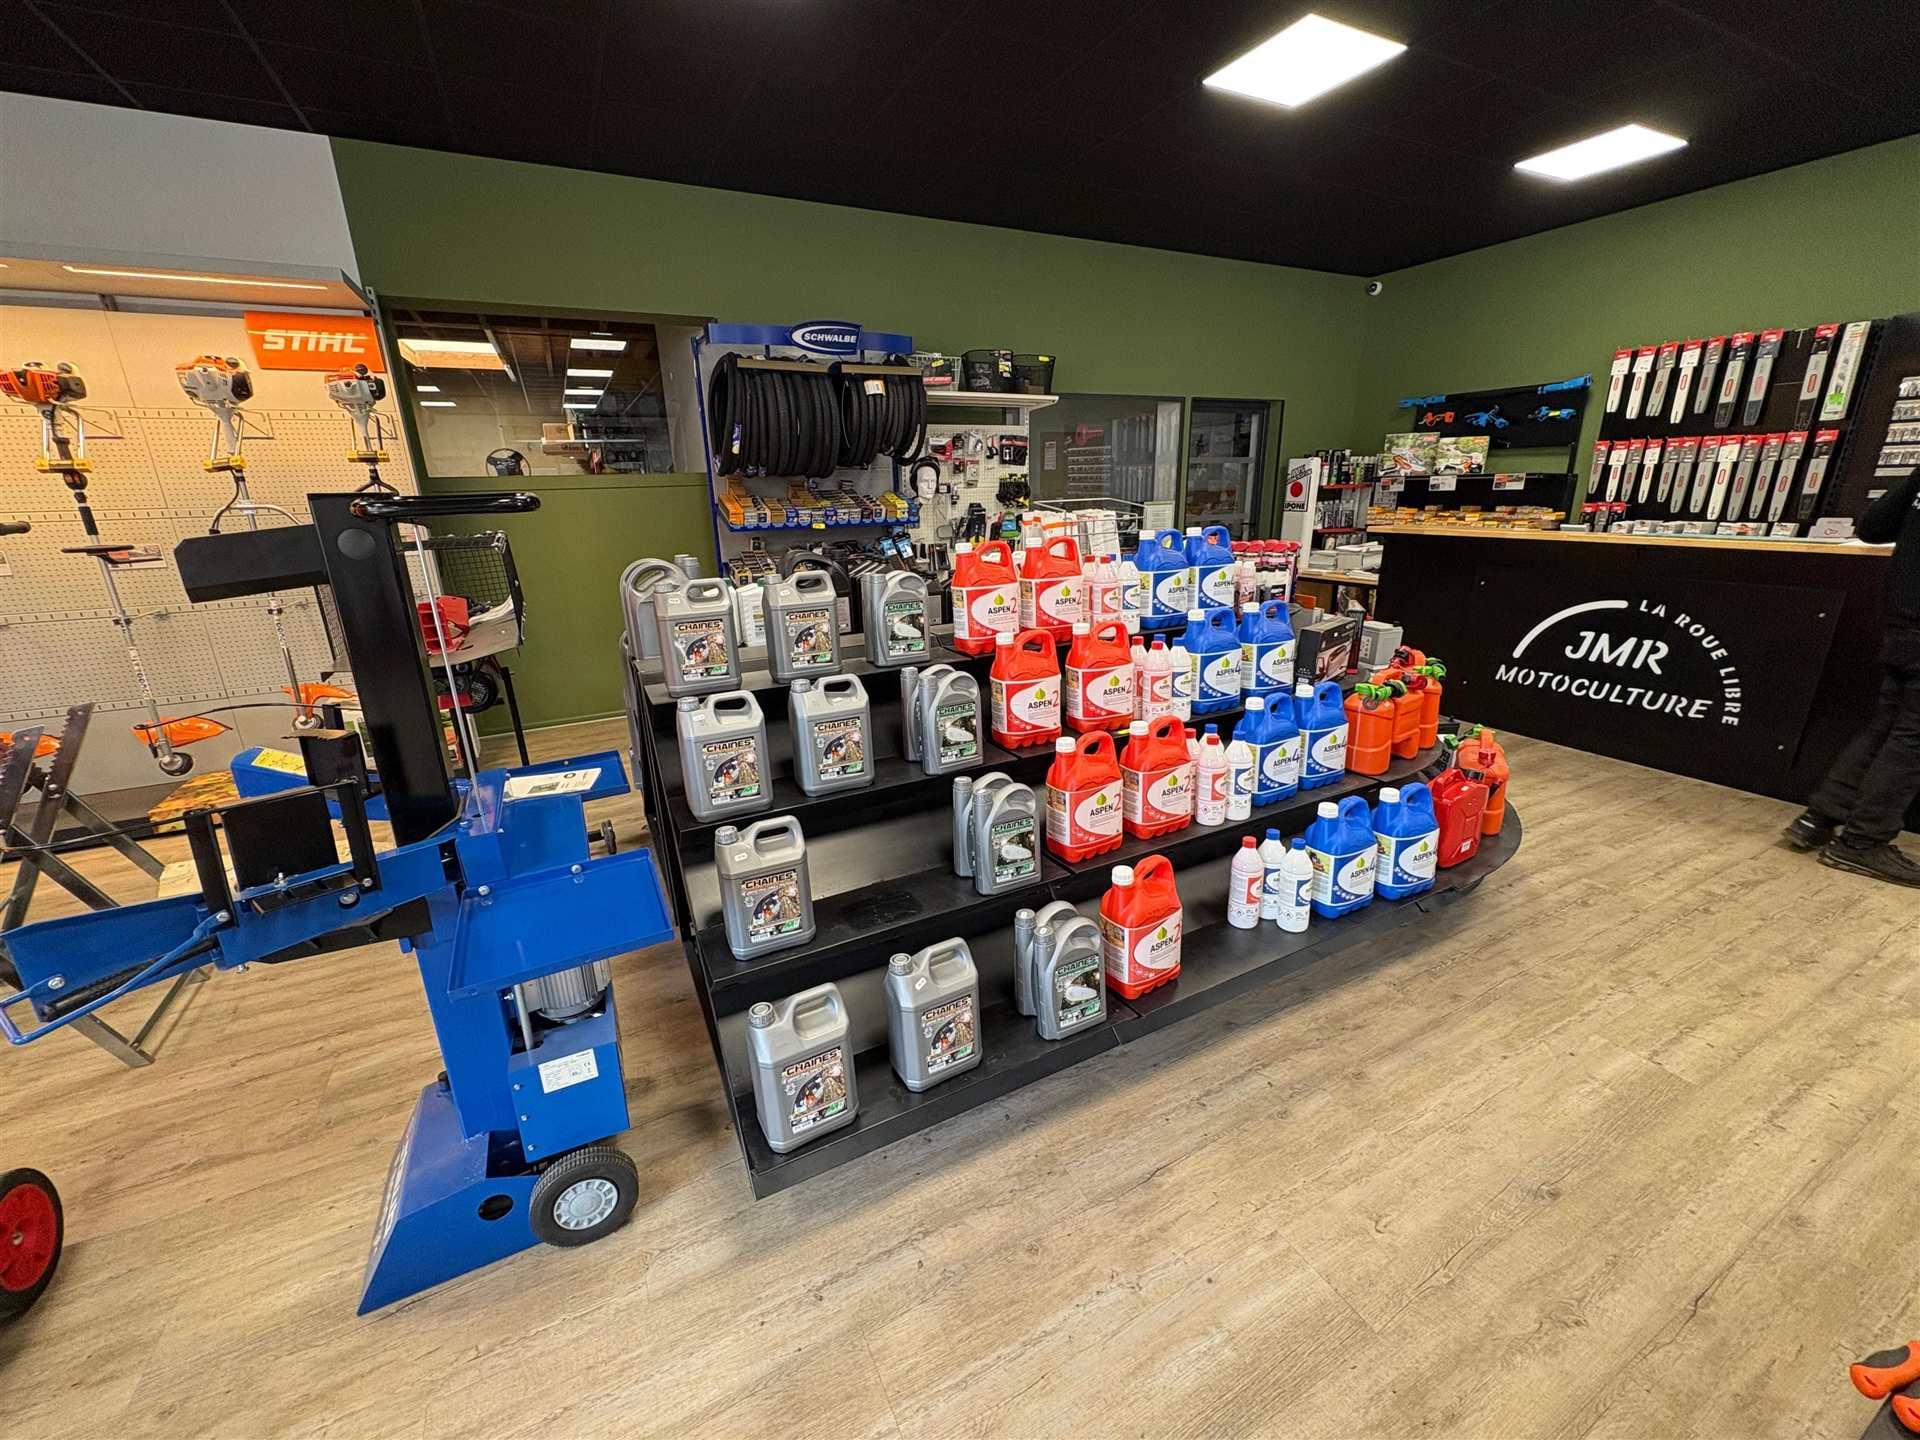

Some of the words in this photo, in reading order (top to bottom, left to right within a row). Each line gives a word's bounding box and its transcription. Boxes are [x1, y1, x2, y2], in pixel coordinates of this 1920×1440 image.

[262, 328, 364, 354] STIHL
[803, 332, 858, 343] SCHWALBE
[987, 605, 1011, 615] ASPEN
[1010, 596, 1018, 614] 2
[1055, 597, 1076, 606] ASPEN
[1076, 588, 1082, 605] 2
[789, 611, 826, 620] CHAINES
[678, 621, 720, 631] CHAINES
[1564, 630, 1670, 676] JMR
[1216, 667, 1235, 677] ASPEN
[1639, 599, 1667, 618] LA
[1673, 612, 1729, 661] ROUE
[1719, 666, 1742, 727] LIBRE
[1103, 686, 1126, 696] ASPEN
[1125, 677, 1133, 695] 2
[1494, 663, 1713, 719] MOTOCULTURE
[1028, 700, 1053, 710] ASPEN
[1051, 689, 1060, 708] 2
[939, 703, 974, 715] CHAINES
[817, 719, 858, 731] CHAINES
[706, 739, 751, 753] CHAINES
[1324, 742, 1341, 753] ASPEN
[1273, 756, 1292, 768] ASPEN
[1291, 748, 1302, 764] 4
[1161, 784, 1185, 797] ASPEN
[1183, 774, 1192, 794] 2
[1089, 803, 1114, 817] ASPEN
[1112, 793, 1122, 813] 2
[994, 818, 1032, 832] CHAINES
[1413, 850, 1433, 862] ASPEN
[745, 873, 793, 889] CHAINES
[1350, 867, 1369, 879] ASPEN
[1150, 935, 1174, 953] ASPEN
[1172, 923, 1181, 945] 2
[1057, 957, 1098, 975] CHAINES
[925, 998, 968, 1020] CHAINES
[786, 1049, 838, 1076] CHAINES
